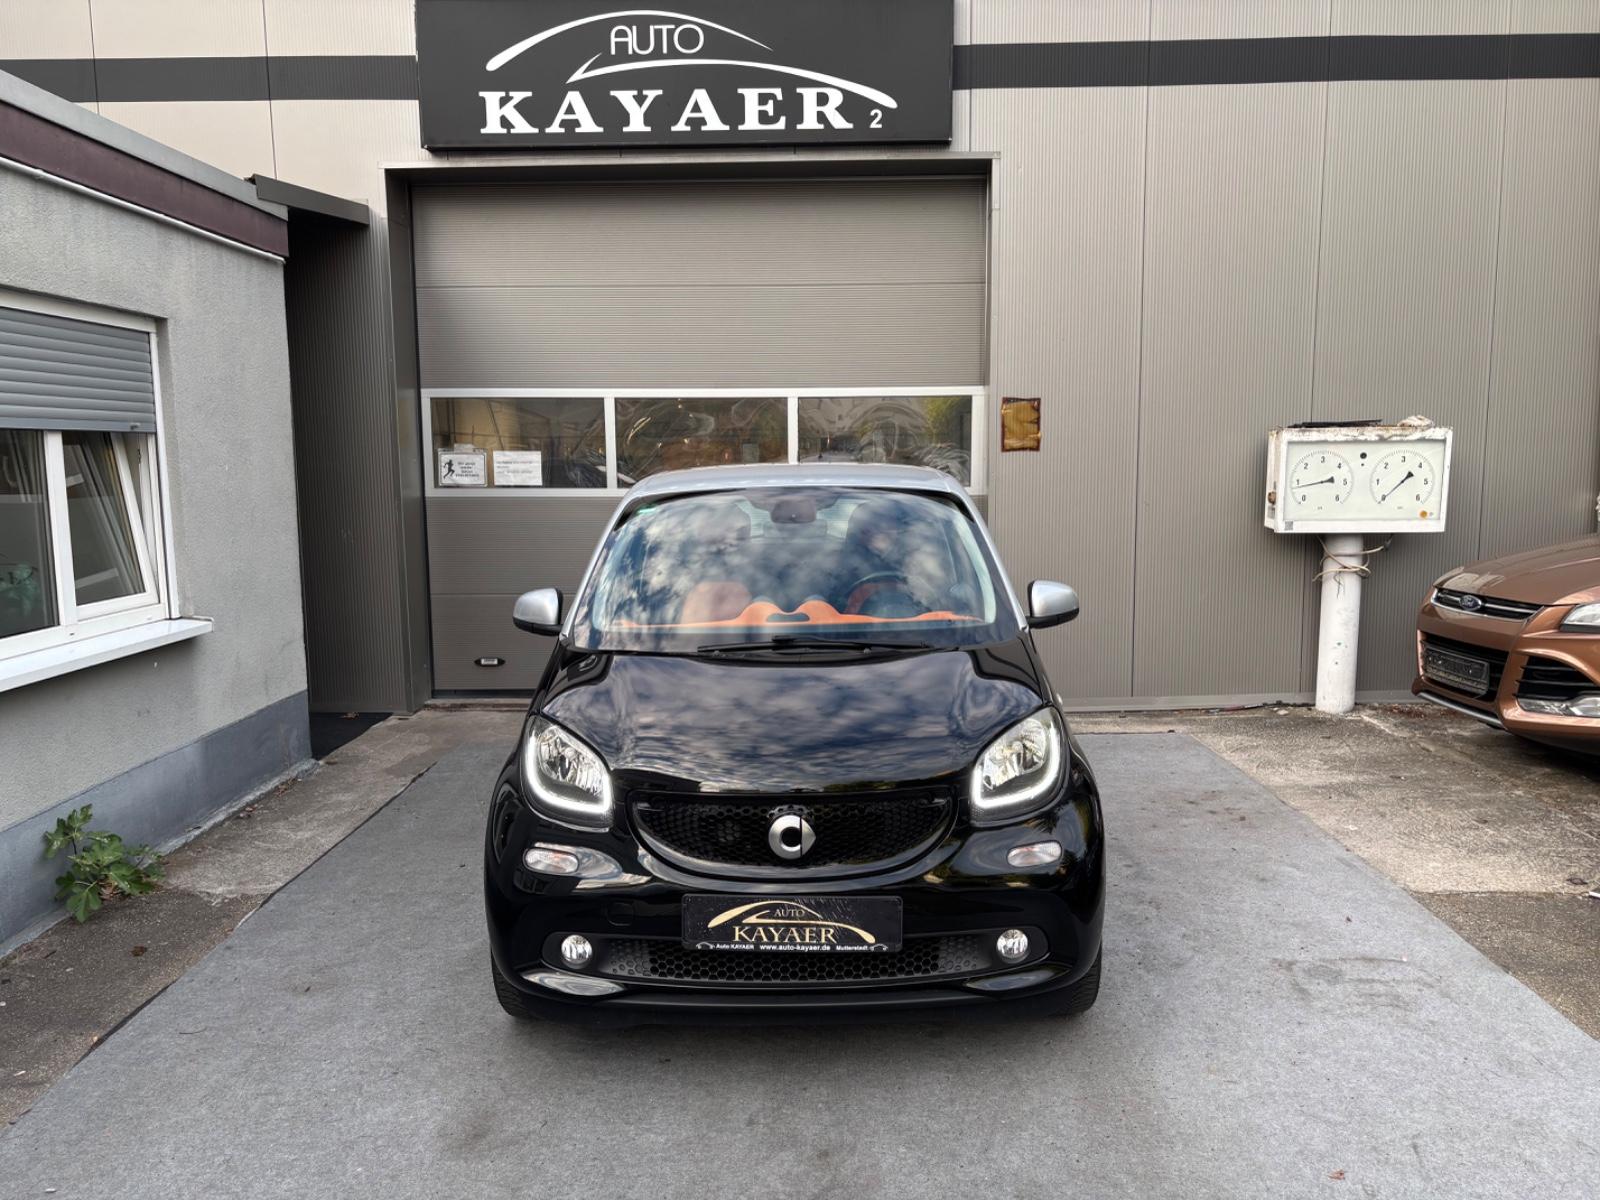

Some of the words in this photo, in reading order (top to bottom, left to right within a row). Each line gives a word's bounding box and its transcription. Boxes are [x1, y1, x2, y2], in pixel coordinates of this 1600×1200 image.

[609, 24, 706, 56] AUTO
[478, 86, 854, 135] KAYAER
[869, 108, 884, 129] 2
[1320, 455, 1326, 464] 3
[1401, 455, 1406, 463] 3
[1303, 462, 1309, 470] 2
[1336, 462, 1342, 470] 4
[1383, 461, 1389, 470] 2
[1417, 461, 1423, 469] 4
[1295, 478, 1300, 486] 1
[1342, 478, 1348, 486] 5
[1376, 478, 1380, 486] 1
[1423, 477, 1429, 486] 5
[1301, 494, 1307, 502] 0
[1334, 494, 1340, 502] 6
[1415, 493, 1421, 502] 6
[774, 908, 806, 918] AUTO
[733, 926, 837, 944] KAYAER
[730, 943, 755, 951] KAYAER
[759, 943, 831, 953] www.auto-kayaer.de
